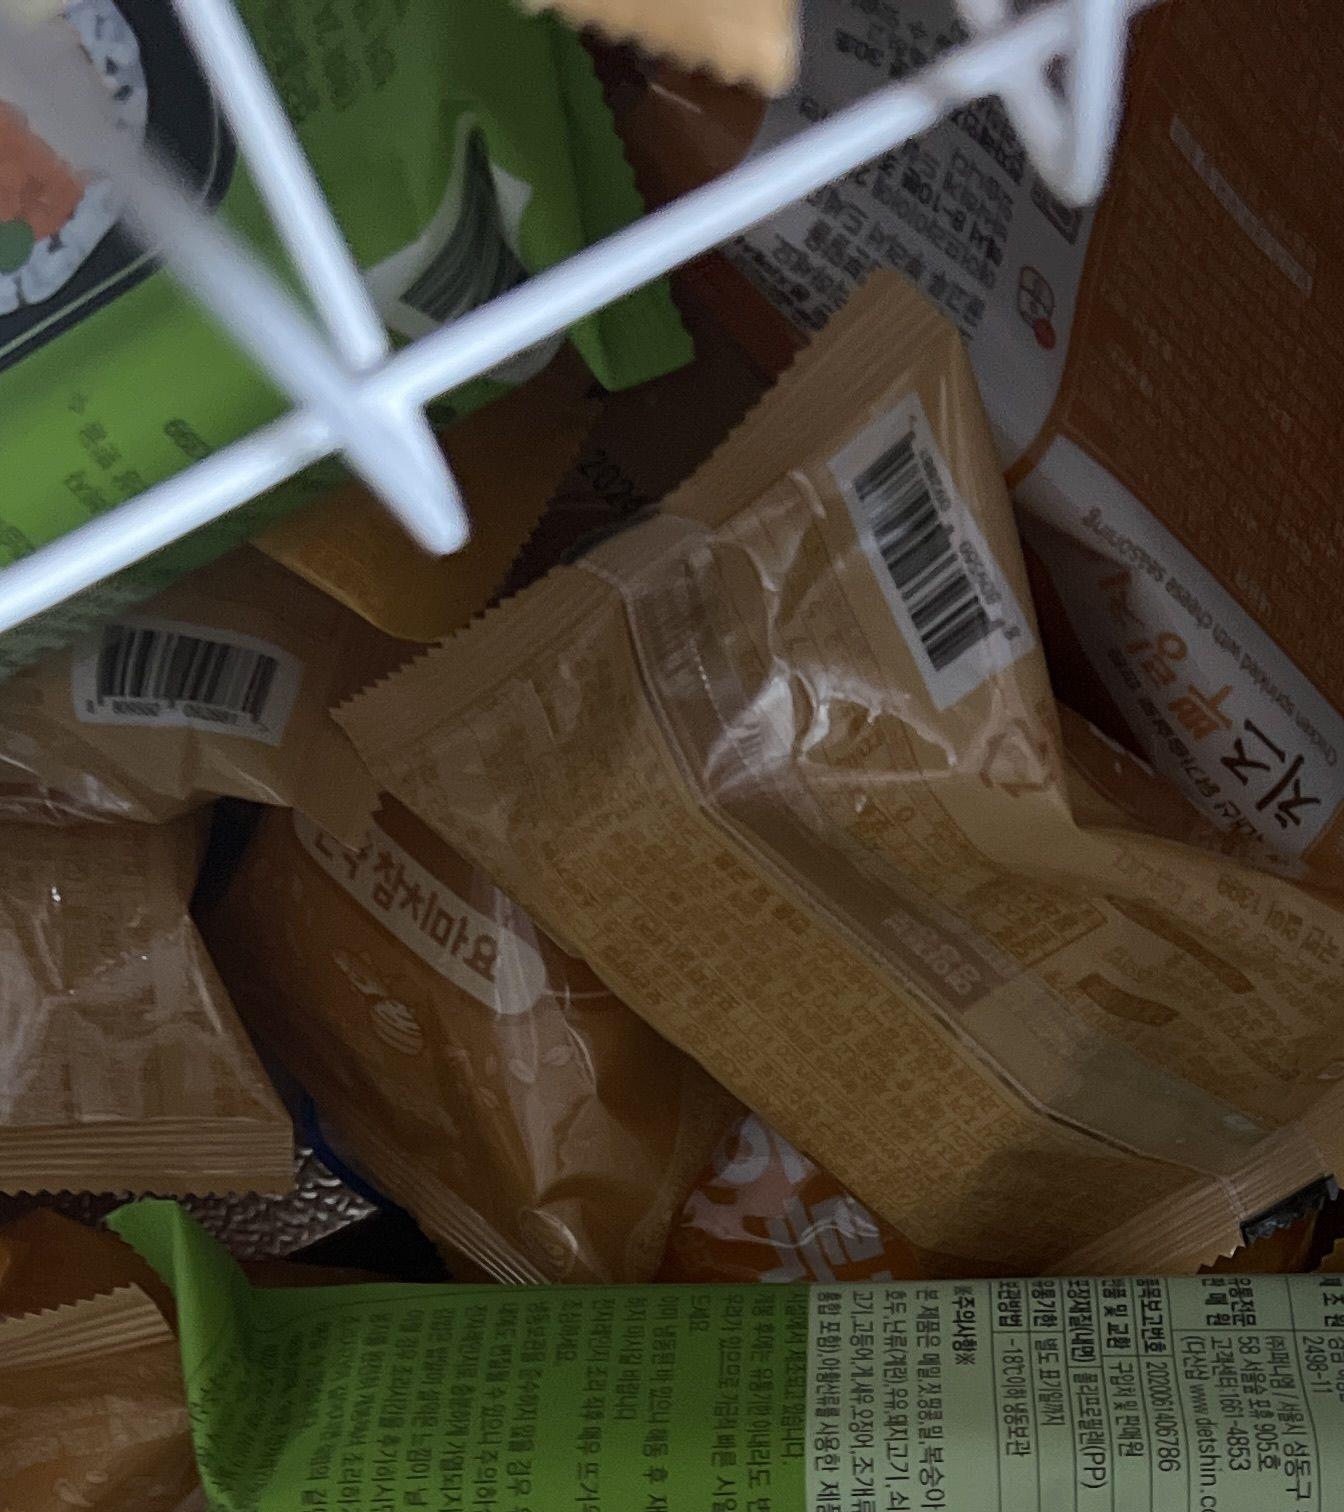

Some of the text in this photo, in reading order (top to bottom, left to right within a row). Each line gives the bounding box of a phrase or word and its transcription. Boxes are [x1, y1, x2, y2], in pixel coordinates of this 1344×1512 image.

[1220, 720, 1322, 828] 치즈
[375, 851, 499, 977] 참치마요
[916, 1305, 940, 1347] 제품은
[997, 1281, 1023, 1327] 보관방법
[1031, 1280, 1058, 1327] 유통기한
[1103, 1304, 1128, 1317] 및
[1106, 1323, 1131, 1349] 교환
[1066, 1280, 1109, 1489] 포장재질(내면) 폴리프로필렌(PP)
[1302, 1336, 1333, 1394] 2498-11
[1039, 1368, 1066, 1426] 표기일까지
[1108, 1362, 1144, 1457] 구입처 및 판매원
[1238, 1336, 1260, 1355] 58
[1254, 1424, 1281, 1471] 905호
[711, 1435, 738, 1467] 빠른
[1003, 1403, 1032, 1457] 냉동보관
[643, 1466, 669, 1484] 후
[1282, 1442, 1312, 1500] 성동구
